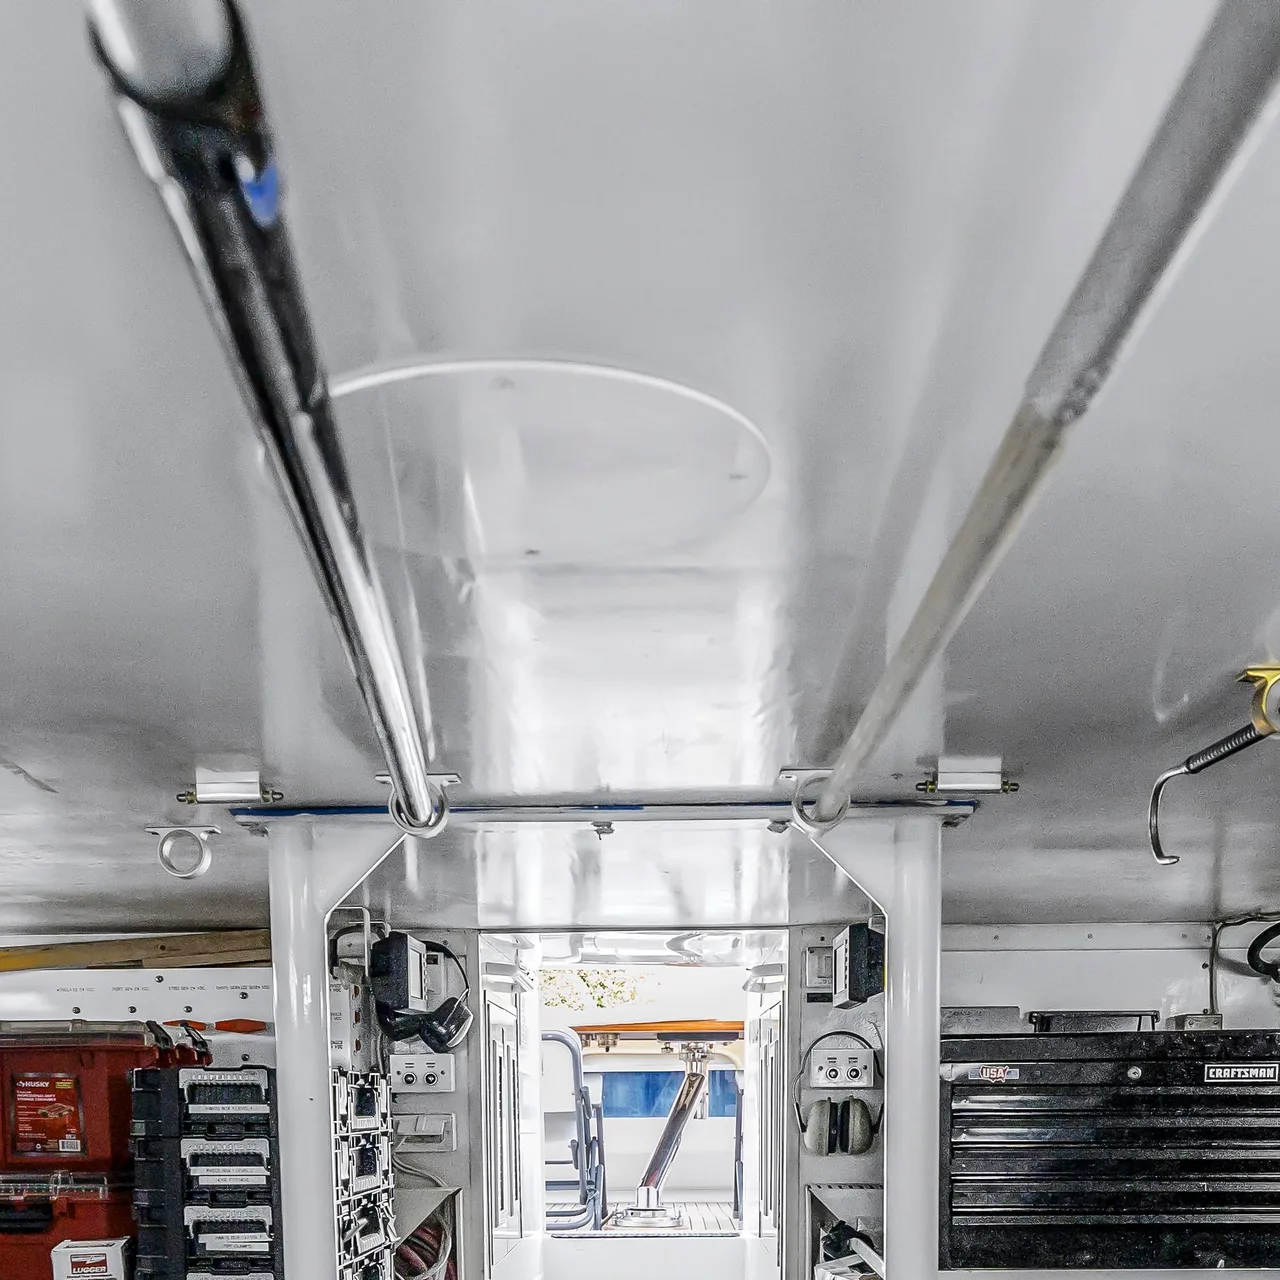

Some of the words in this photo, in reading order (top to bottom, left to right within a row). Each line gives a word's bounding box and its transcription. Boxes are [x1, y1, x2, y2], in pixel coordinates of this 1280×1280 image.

[982, 1068, 1005, 1078] USA
[1209, 1068, 1275, 1078] CRAFTSMAN
[73, 1266, 107, 1274] LUGGER
